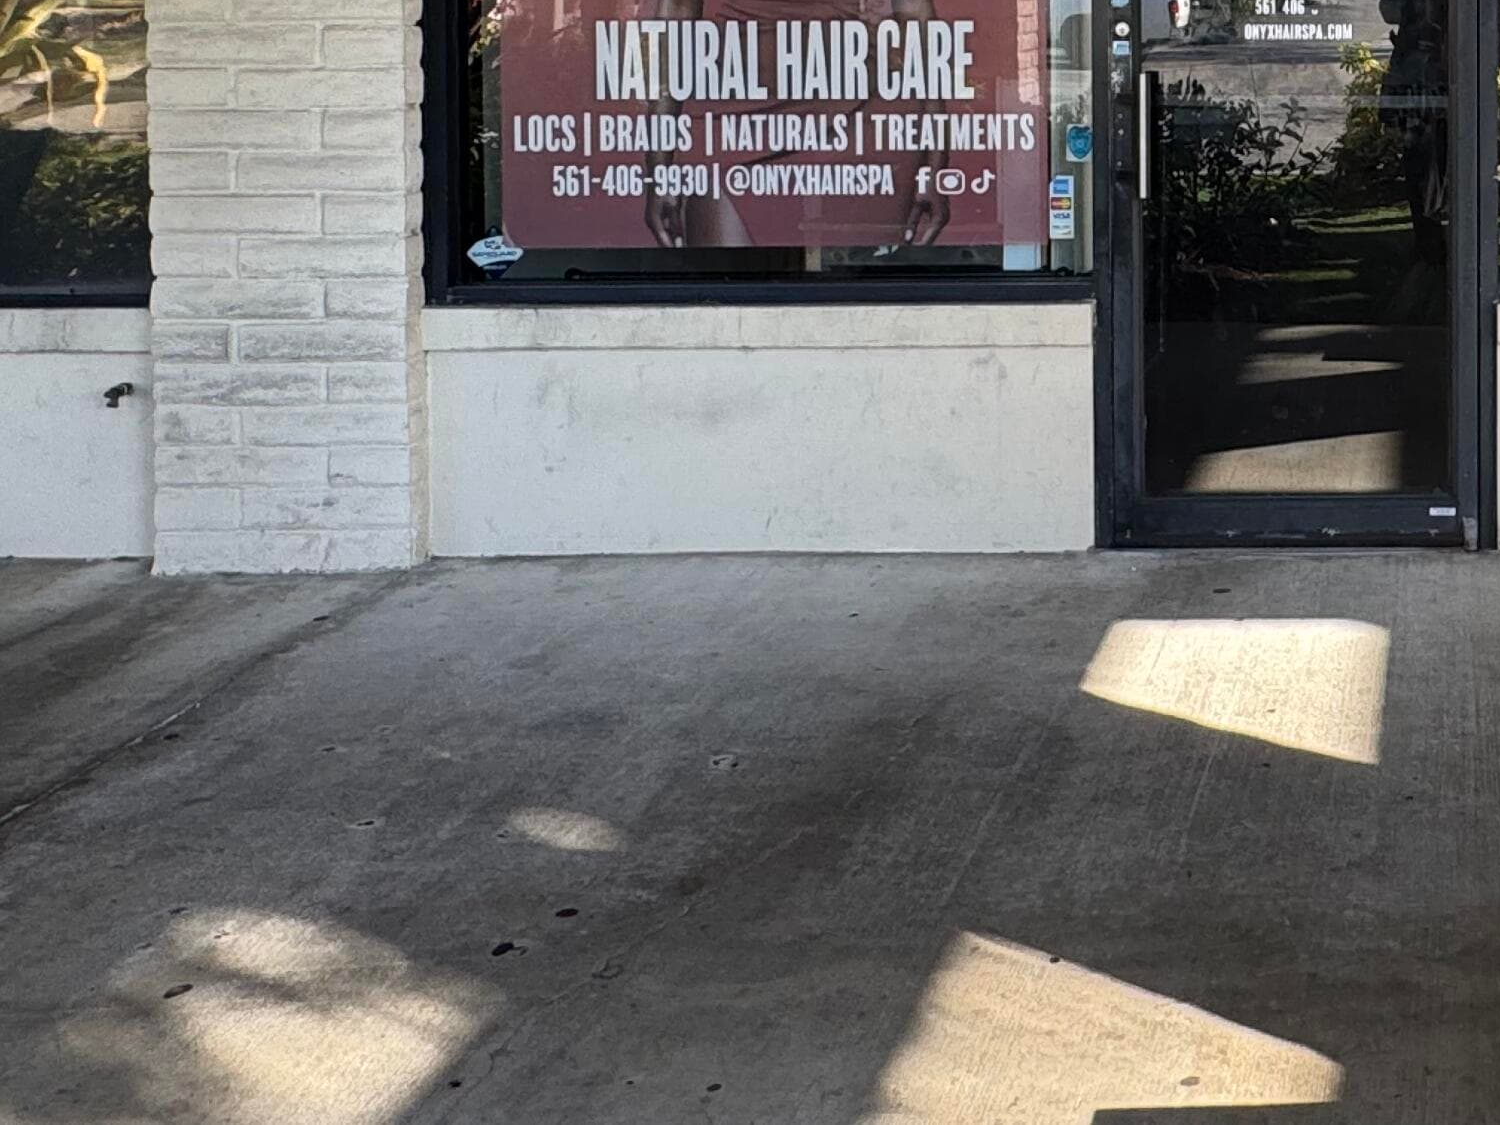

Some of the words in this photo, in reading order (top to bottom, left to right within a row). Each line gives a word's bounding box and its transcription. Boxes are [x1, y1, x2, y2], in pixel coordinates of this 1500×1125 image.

[1244, 23, 1353, 40] ONYXHAIRSPA.COM
[595, 20, 768, 100] NATURAL
[777, 20, 869, 100] HAIR
[877, 19, 975, 101] CARE
[513, 115, 576, 152] LOCS
[600, 114, 692, 152] BRAIDS
[721, 114, 849, 151] NATURALS
[871, 113, 1035, 151] TREATMENTS
[553, 165, 708, 196] 561-406-9930
[726, 164, 895, 196] @ONYXHAIRSPA
